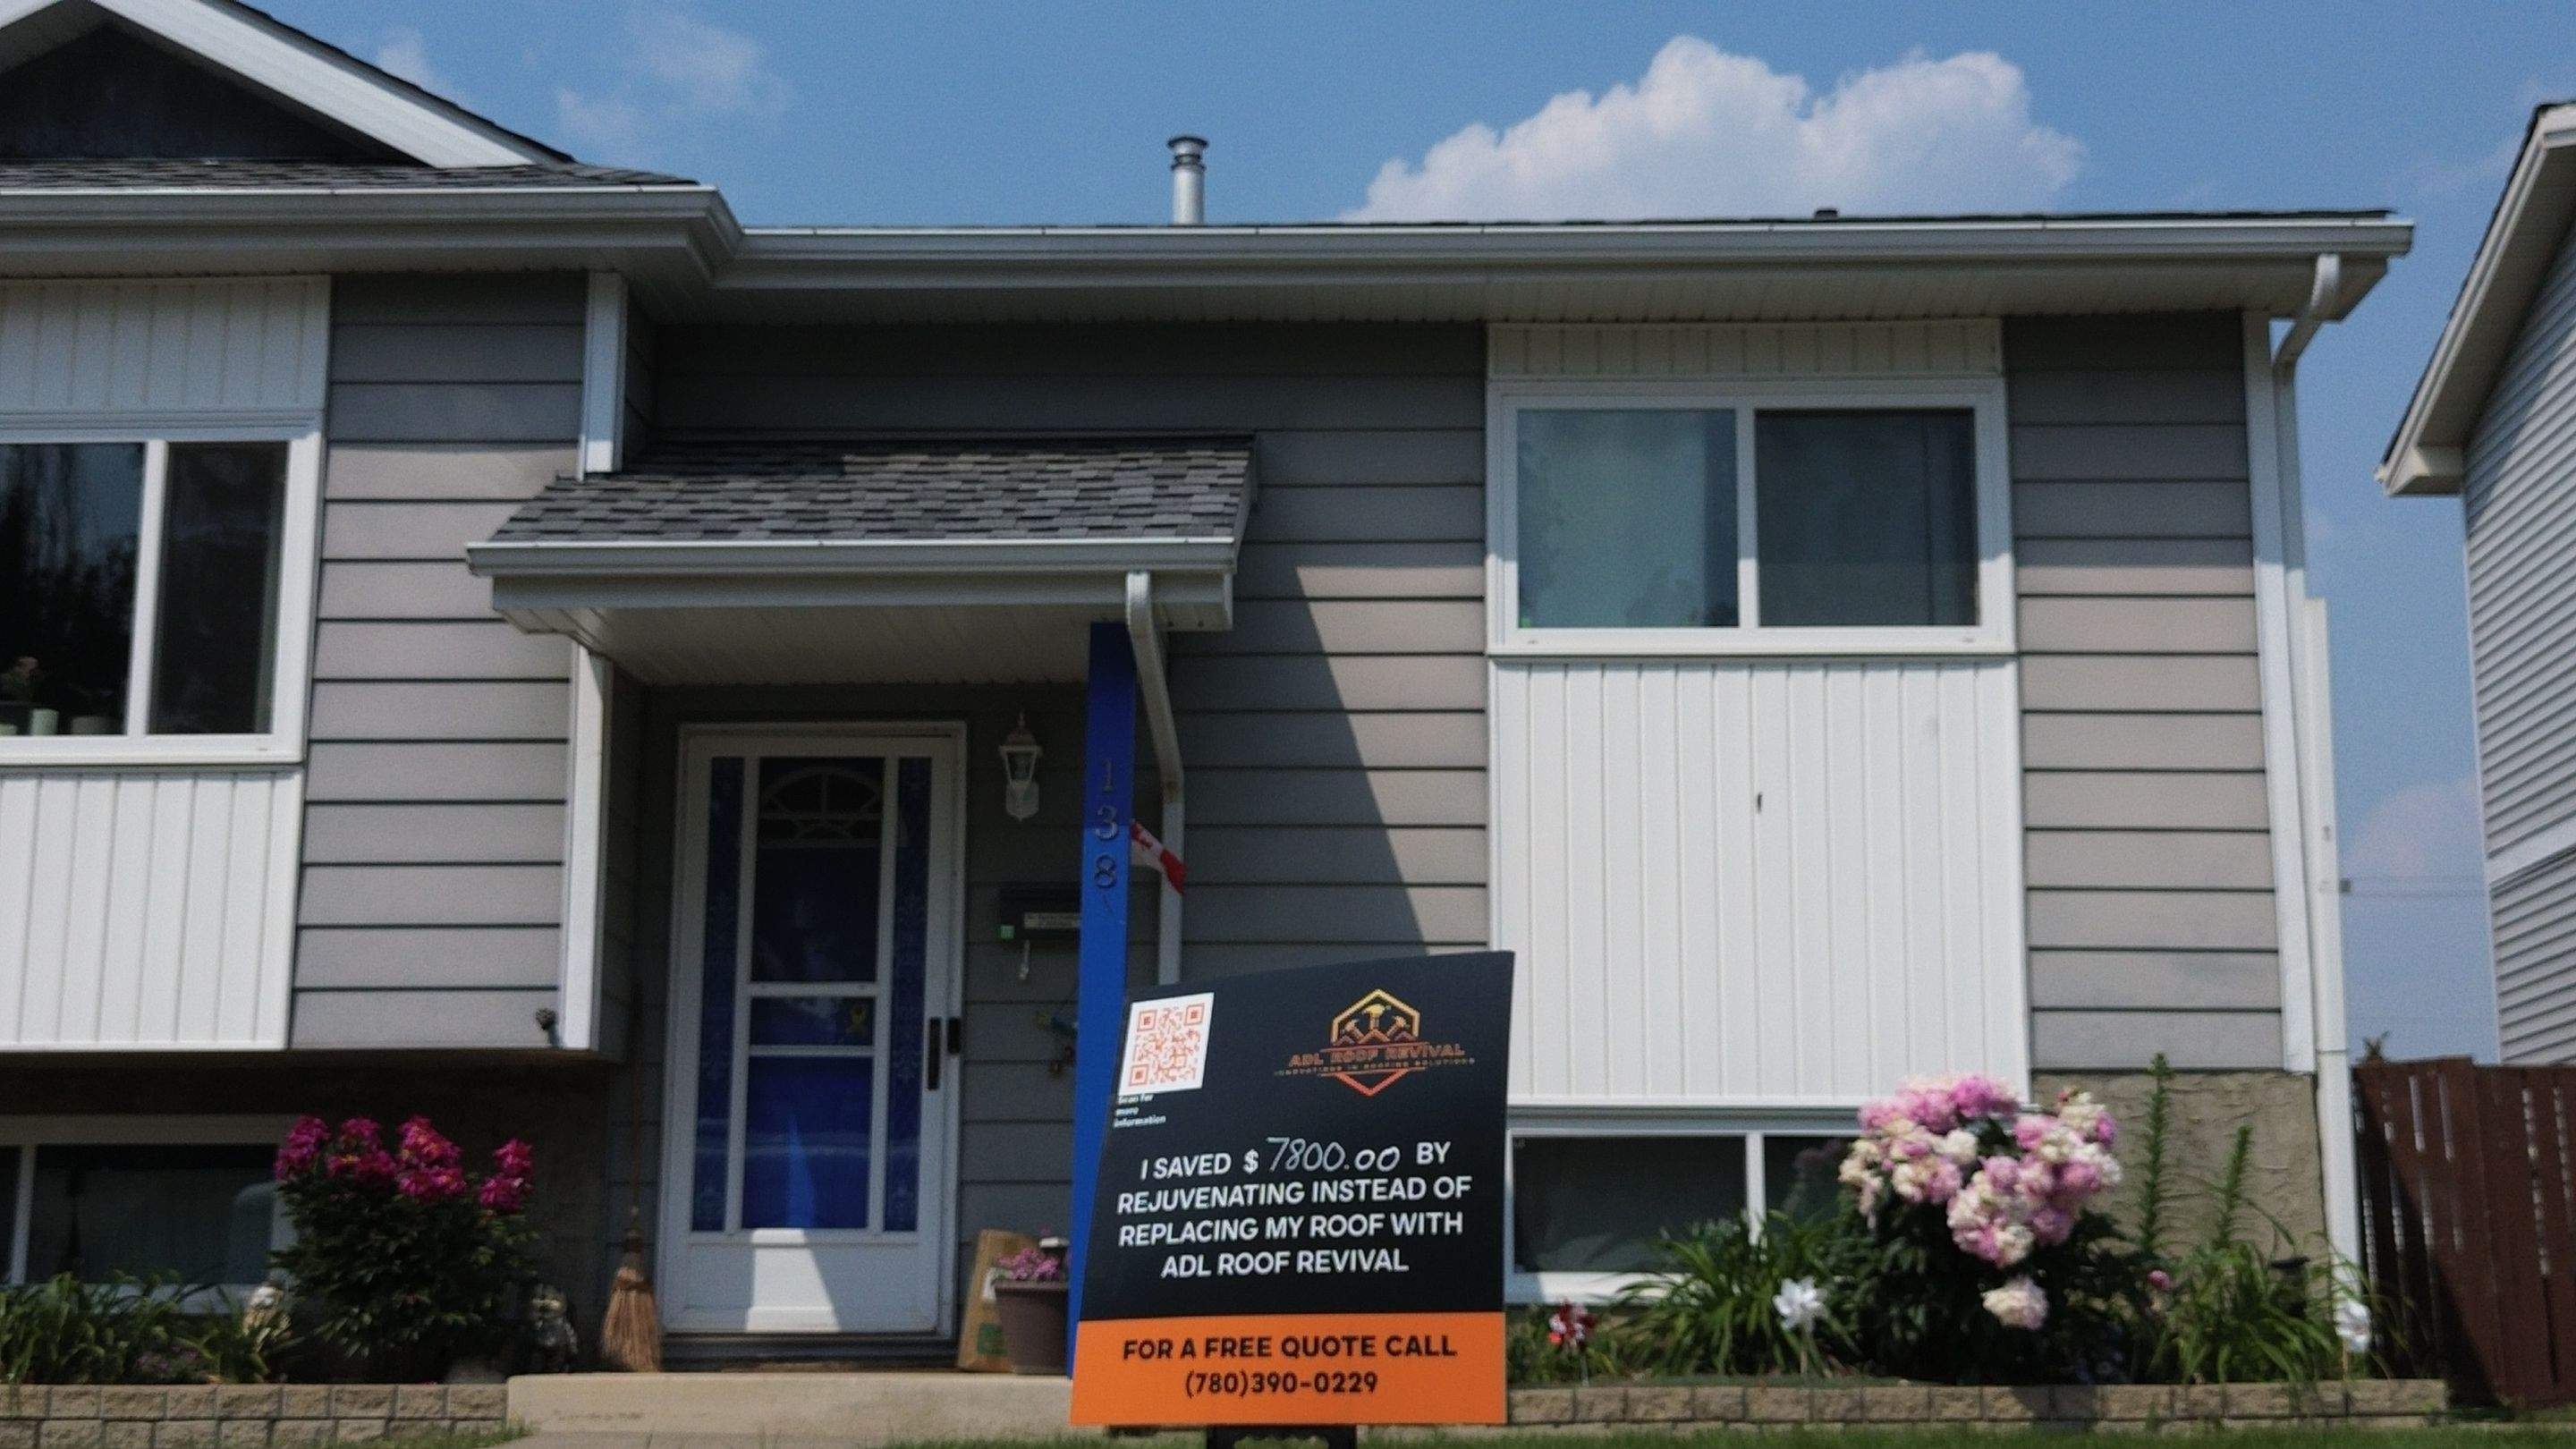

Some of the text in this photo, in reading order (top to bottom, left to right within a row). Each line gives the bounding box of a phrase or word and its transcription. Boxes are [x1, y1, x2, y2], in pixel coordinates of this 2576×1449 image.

[1093, 758, 1118, 889] 138
[1289, 1053, 1324, 1067] ADL
[1386, 1043, 1465, 1060] REVIVAL
[1114, 1114, 1166, 1127] information
[1140, 1137, 1452, 1181] I SAVED $ 7800.00 BY
[1116, 1175, 1472, 1214] REJUVENATING INSTEAD OF
[1118, 1211, 1463, 1247] REPLACING MY ROOF WITH
[1160, 1248, 1410, 1278] ADL ROOF REVIVAL
[1123, 1335, 1458, 1360] FOR A FREE QUOTE CALL
[1186, 1369, 1377, 1399] (780)390-0229
